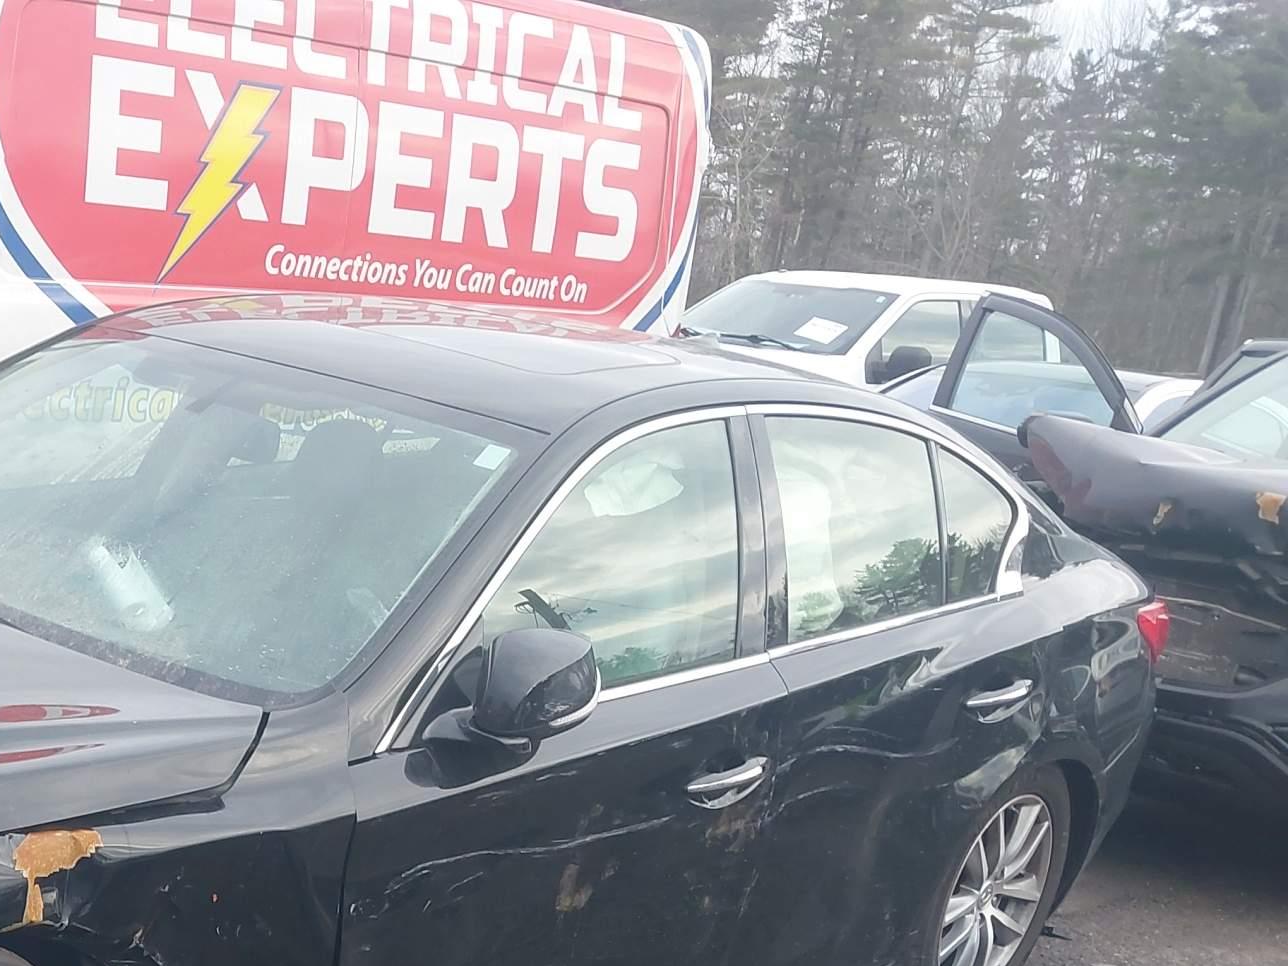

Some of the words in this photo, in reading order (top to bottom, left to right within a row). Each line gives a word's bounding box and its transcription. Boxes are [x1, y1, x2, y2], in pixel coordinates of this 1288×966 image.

[85, 54, 643, 263] EXPERTS
[265, 243, 409, 287] Connections
[413, 258, 452, 290] You
[455, 263, 496, 294] Can
[499, 267, 559, 300] Count
[560, 274, 588, 304] On
